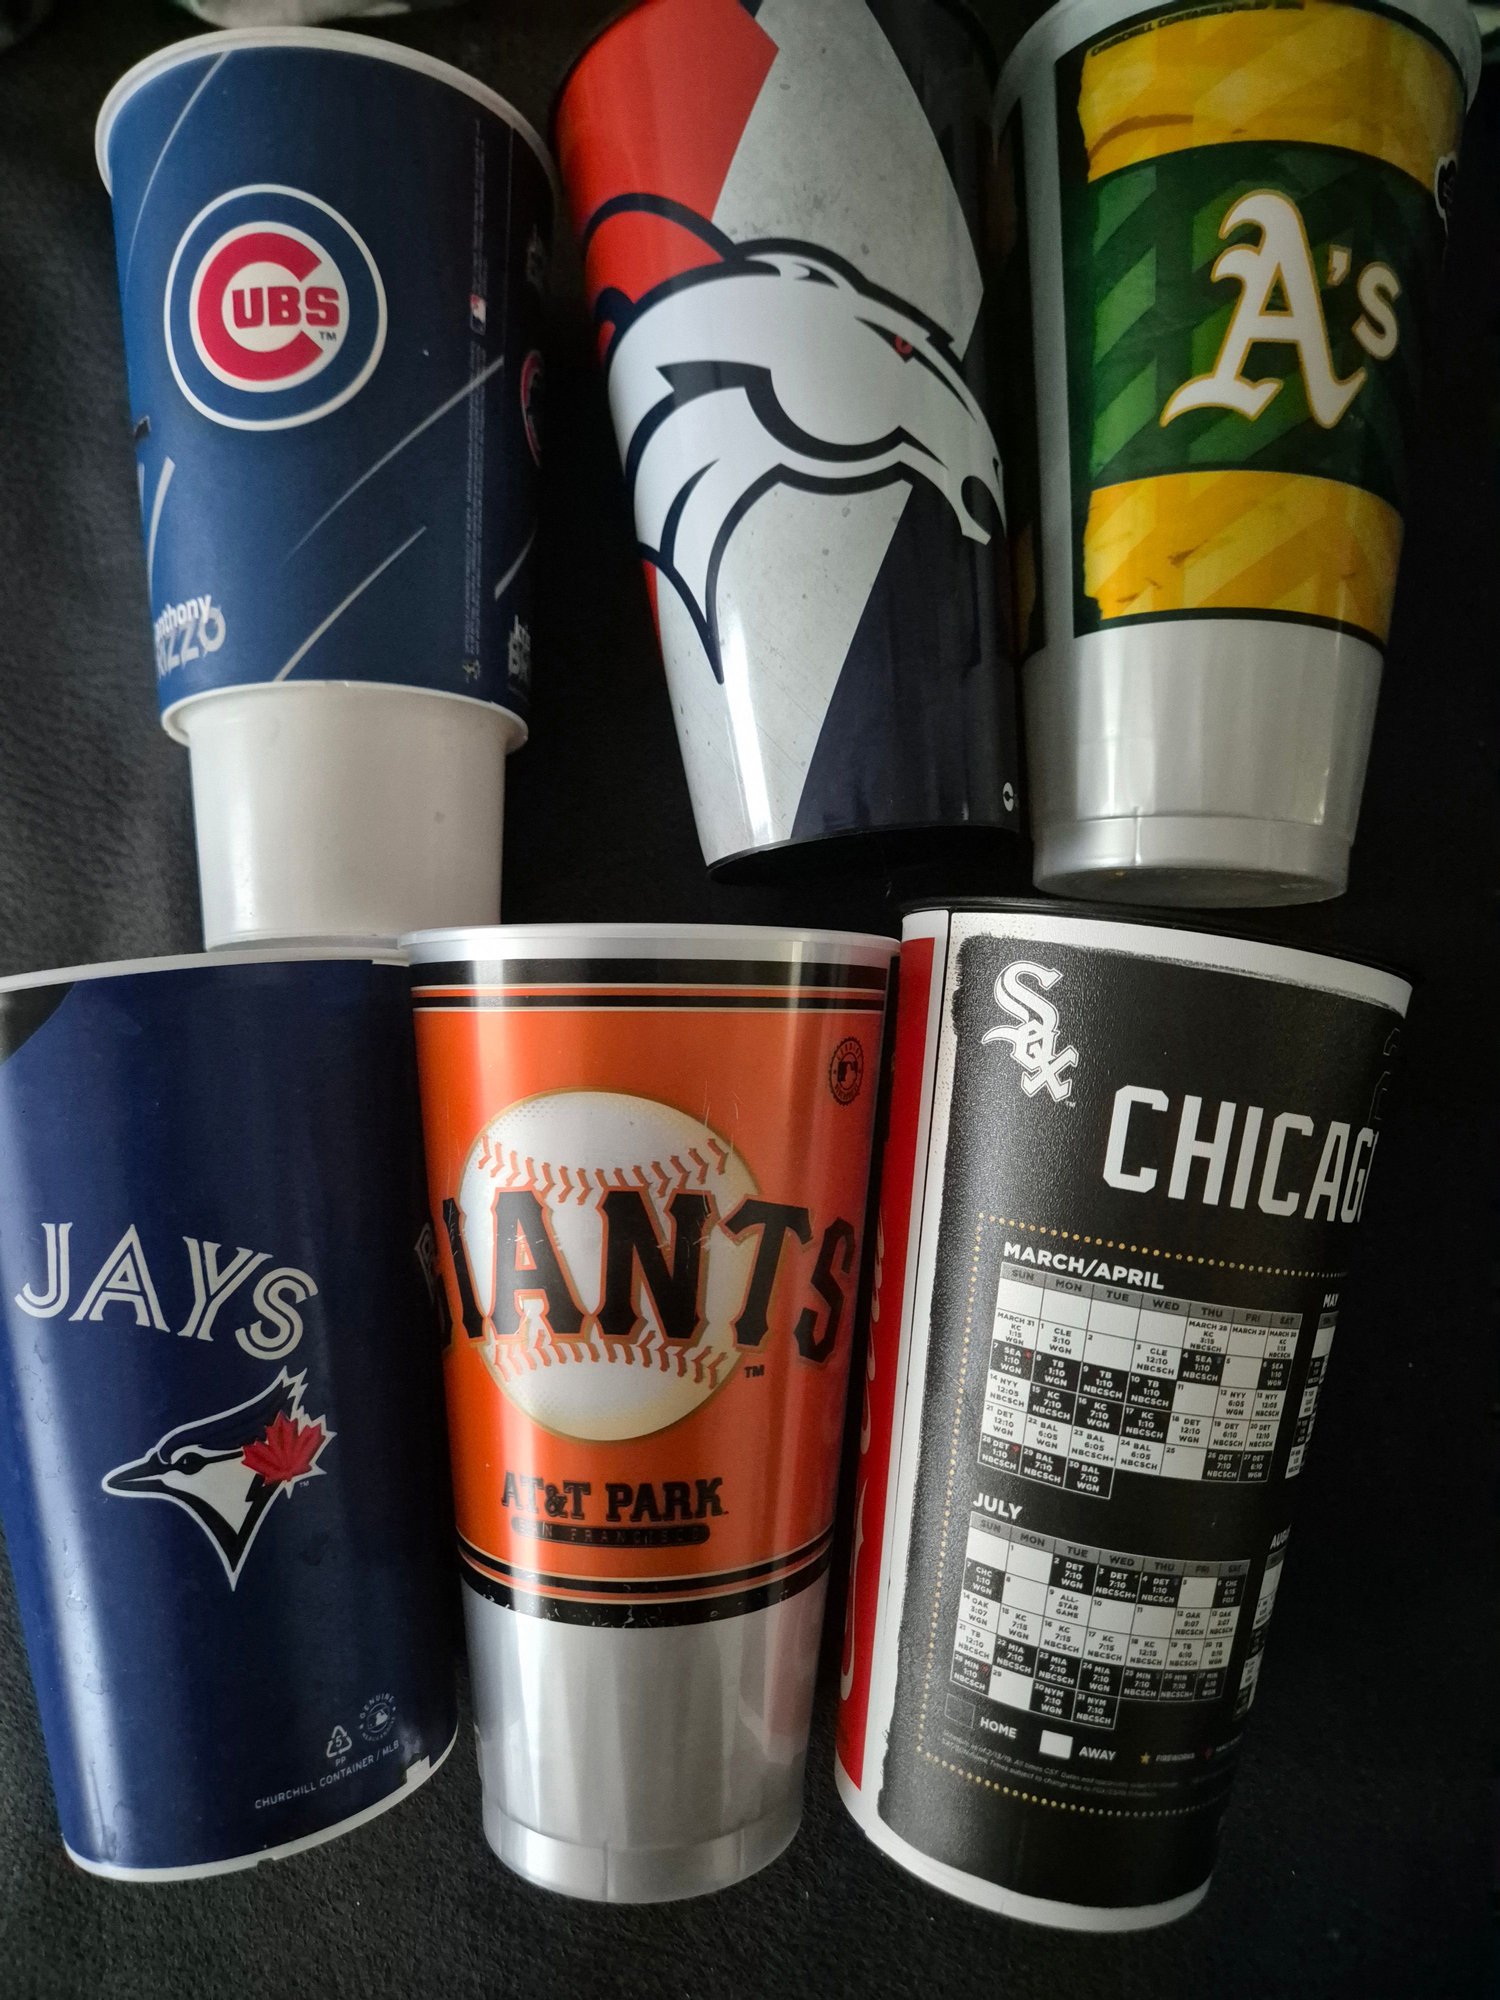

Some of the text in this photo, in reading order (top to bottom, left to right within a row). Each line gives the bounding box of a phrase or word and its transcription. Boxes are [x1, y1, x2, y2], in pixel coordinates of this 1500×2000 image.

[197, 231, 340, 382] CUBS
[1161, 188, 1403, 428] A's
[1102, 1084, 1379, 1226] CHICAG
[1003, 1241, 1165, 1290] MARCH/APRIL
[440, 1186, 857, 1364] IANTS
[15, 1222, 319, 1361] JAYS
[1011, 1269, 1035, 1281] SUN
[1055, 1279, 1082, 1292] MON
[1106, 1289, 1130, 1302] TUE
[1152, 1299, 1180, 1311] WED
[997, 1312, 1035, 1327] MARCH 31
[1010, 1323, 1021, 1331] KC
[1053, 1327, 1072, 1337] CLE
[1005, 1336, 1024, 1346] WGN
[1004, 1346, 1021, 1357] SEA
[1049, 1343, 1072, 1355] WGN
[1149, 1347, 1167, 1357] CLE
[1000, 1362, 1021, 1374] WGN
[1052, 1359, 1064, 1368] TB
[1136, 1362, 1175, 1376] NBCSCH
[744, 1365, 765, 1379] TM
[1099, 1370, 1112, 1379] TB
[999, 1377, 1018, 1388] NYY
[1044, 1374, 1067, 1387] WGN
[1147, 1379, 1159, 1388] TB
[1046, 1390, 1060, 1400] KC
[1082, 1384, 1122, 1399] NBCSCH
[990, 1392, 1025, 1408] NBCSCH
[1093, 1401, 1107, 1411] KC
[1130, 1394, 1169, 1407] NBCSCH
[996, 1408, 1014, 1419] DET
[1032, 1404, 1070, 1420] NBCSCH
[1141, 1411, 1154, 1420] KC
[1040, 1421, 1058, 1432] BAL
[1086, 1417, 1110, 1429] WGN
[993, 1425, 1013, 1437] WGN
[1125, 1426, 1163, 1439] NBCSCH
[992, 1439, 1009, 1450] DET
[1036, 1437, 1058, 1450] WGN
[1086, 1433, 1104, 1443] BAL
[1133, 1442, 1151, 1452] BAL
[1035, 1452, 1053, 1464] BAL
[1071, 1447, 1114, 1462] NBCSCH+
[981, 1453, 1016, 1470] NBCSCH
[1120, 1458, 1158, 1470] NBCSCH
[1023, 1466, 1061, 1483] NBCSCH
[1080, 1464, 1099, 1475] BAL
[1076, 1480, 1100, 1492] WGN
[501, 1471, 724, 1522] AT&T PARK
[973, 1492, 1023, 1520] JULY
[980, 1716, 1018, 1739] HOME
[335, 1735, 342, 1748] 5
[1078, 1746, 1116, 1761] AWAY
[335, 1755, 347, 1768] PP
[254, 1781, 317, 1809] CHURCHILL
[319, 1754, 374, 1787] CONTAINER
